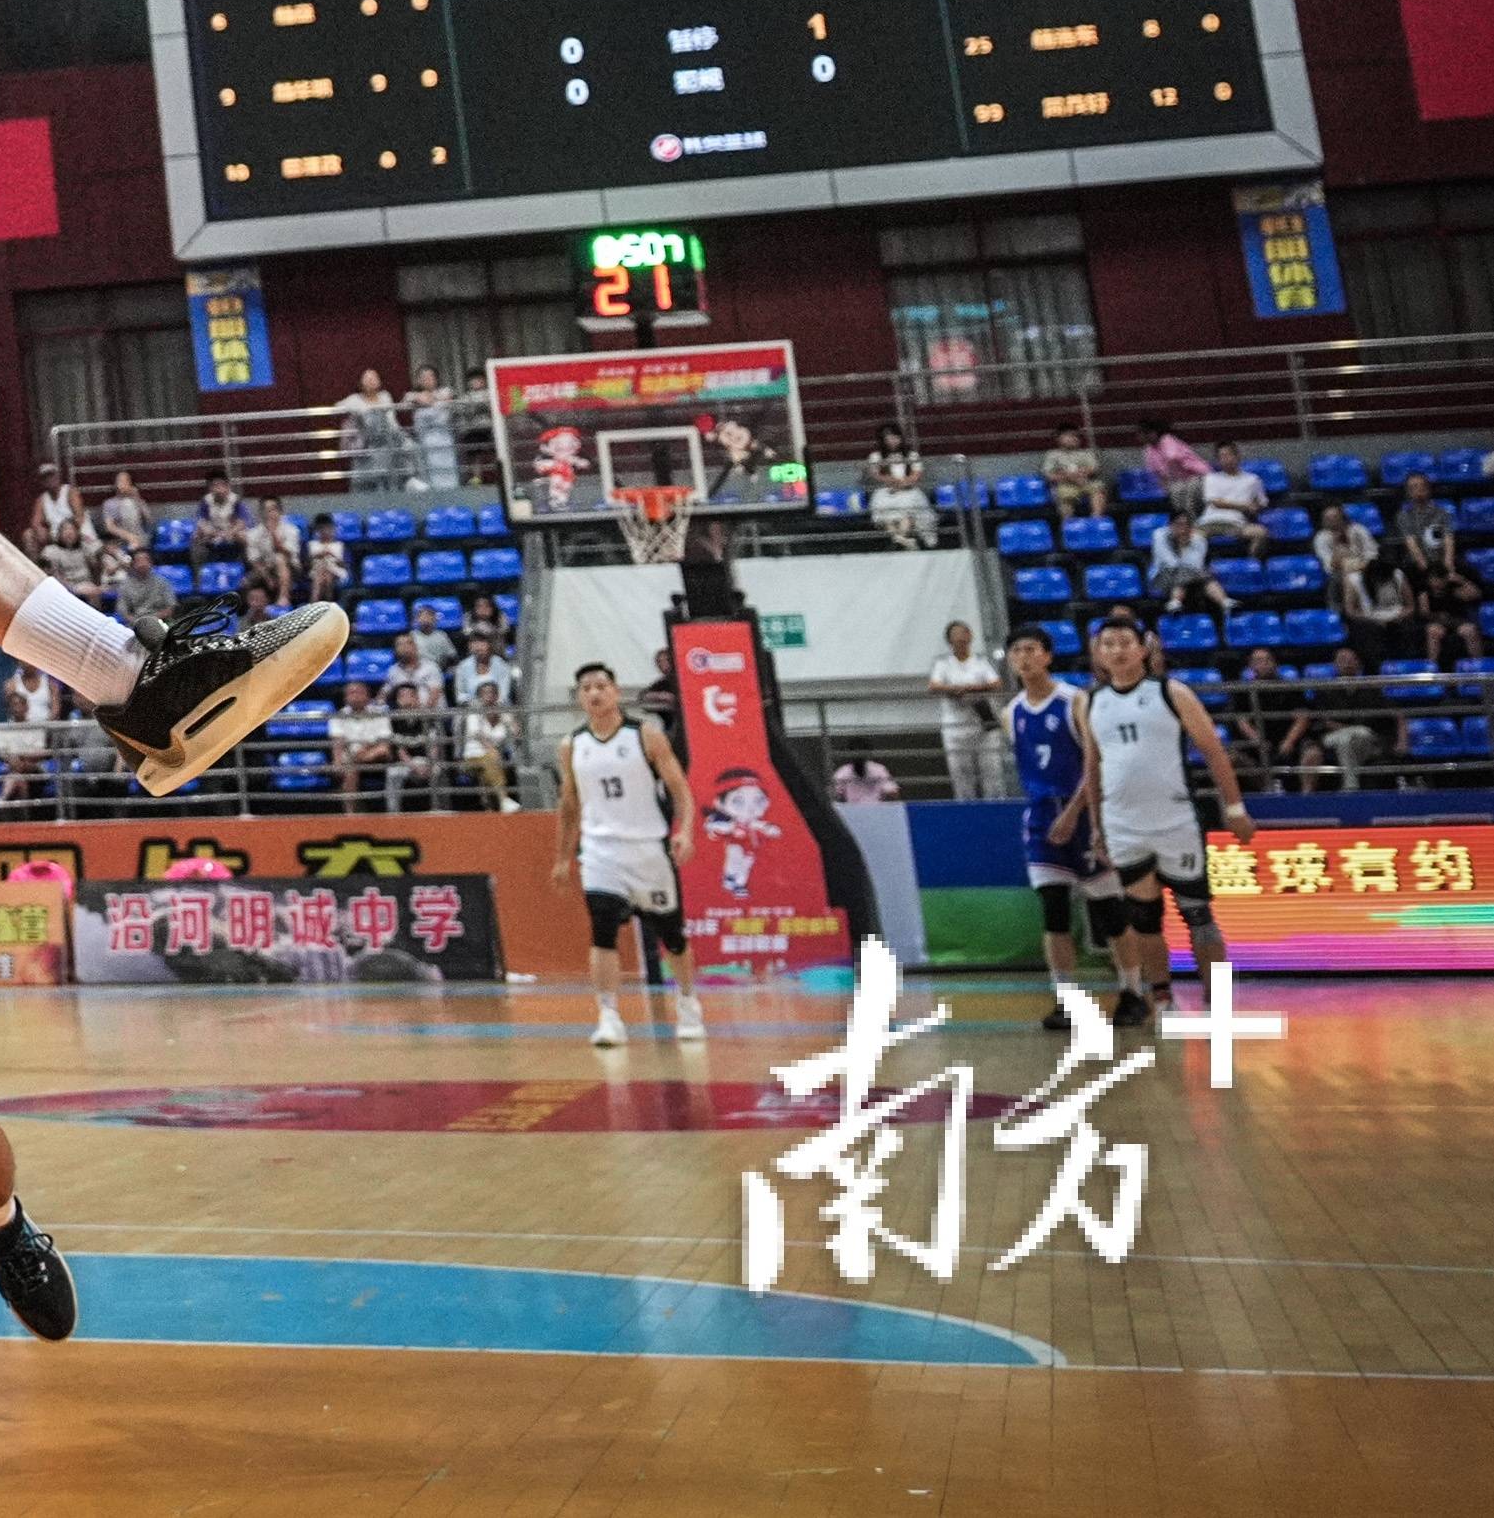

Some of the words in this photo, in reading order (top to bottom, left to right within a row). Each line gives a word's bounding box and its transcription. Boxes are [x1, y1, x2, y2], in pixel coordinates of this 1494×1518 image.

[560, 37, 584, 64] 0
[807, 13, 827, 40] 1
[565, 78, 590, 106] 0
[812, 54, 836, 82] 0
[592, 264, 673, 316] 21
[1035, 746, 1051, 769] 7
[1117, 722, 1140, 744] 11
[600, 777, 623, 800] 13
[1206, 839, 1475, 896] 篮球有约
[109, 885, 467, 956] 沿河明诚中学
